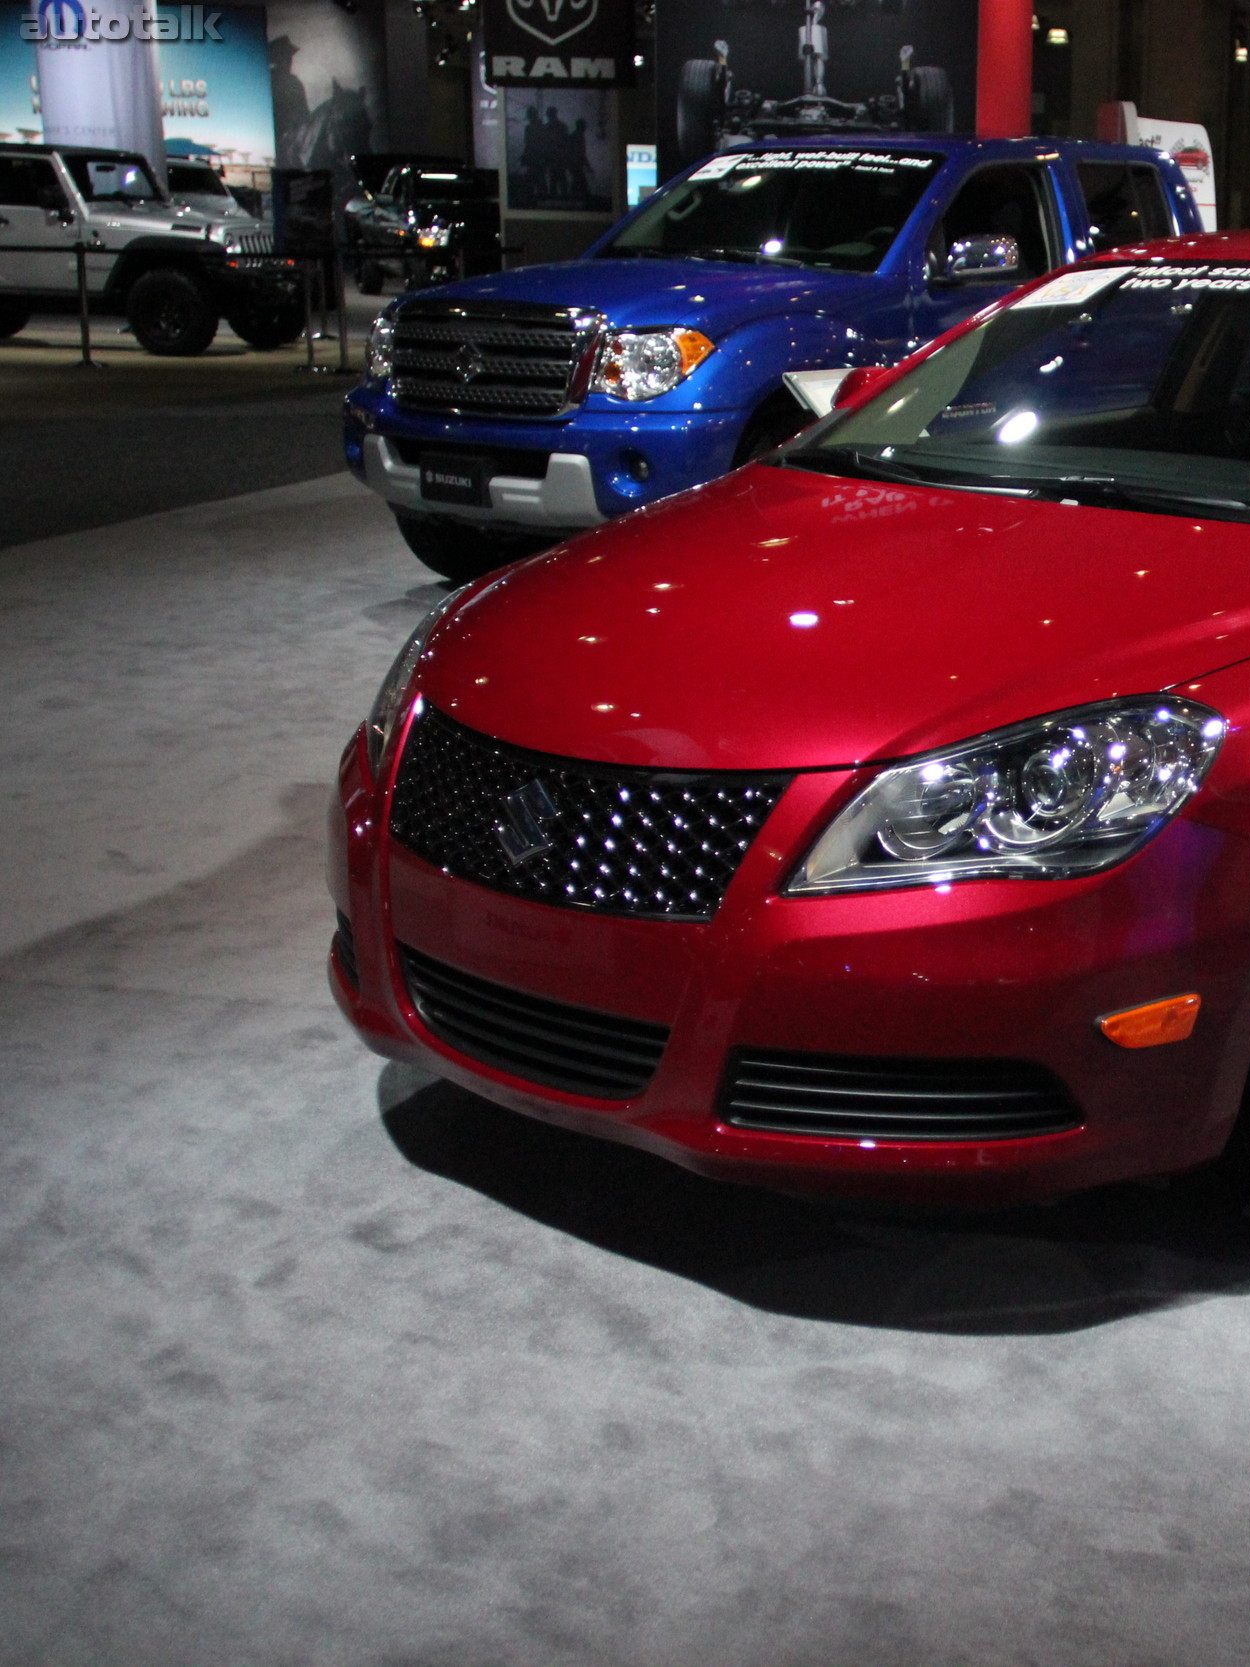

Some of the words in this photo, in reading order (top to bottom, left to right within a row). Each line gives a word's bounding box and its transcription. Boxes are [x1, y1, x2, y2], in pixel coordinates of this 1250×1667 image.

[492, 56, 615, 79] RAM
[169, 80, 208, 99] LBS
[735, 160, 797, 170] excellent
[1119, 277, 1172, 289] two
[435, 473, 472, 488] SUZUKI
